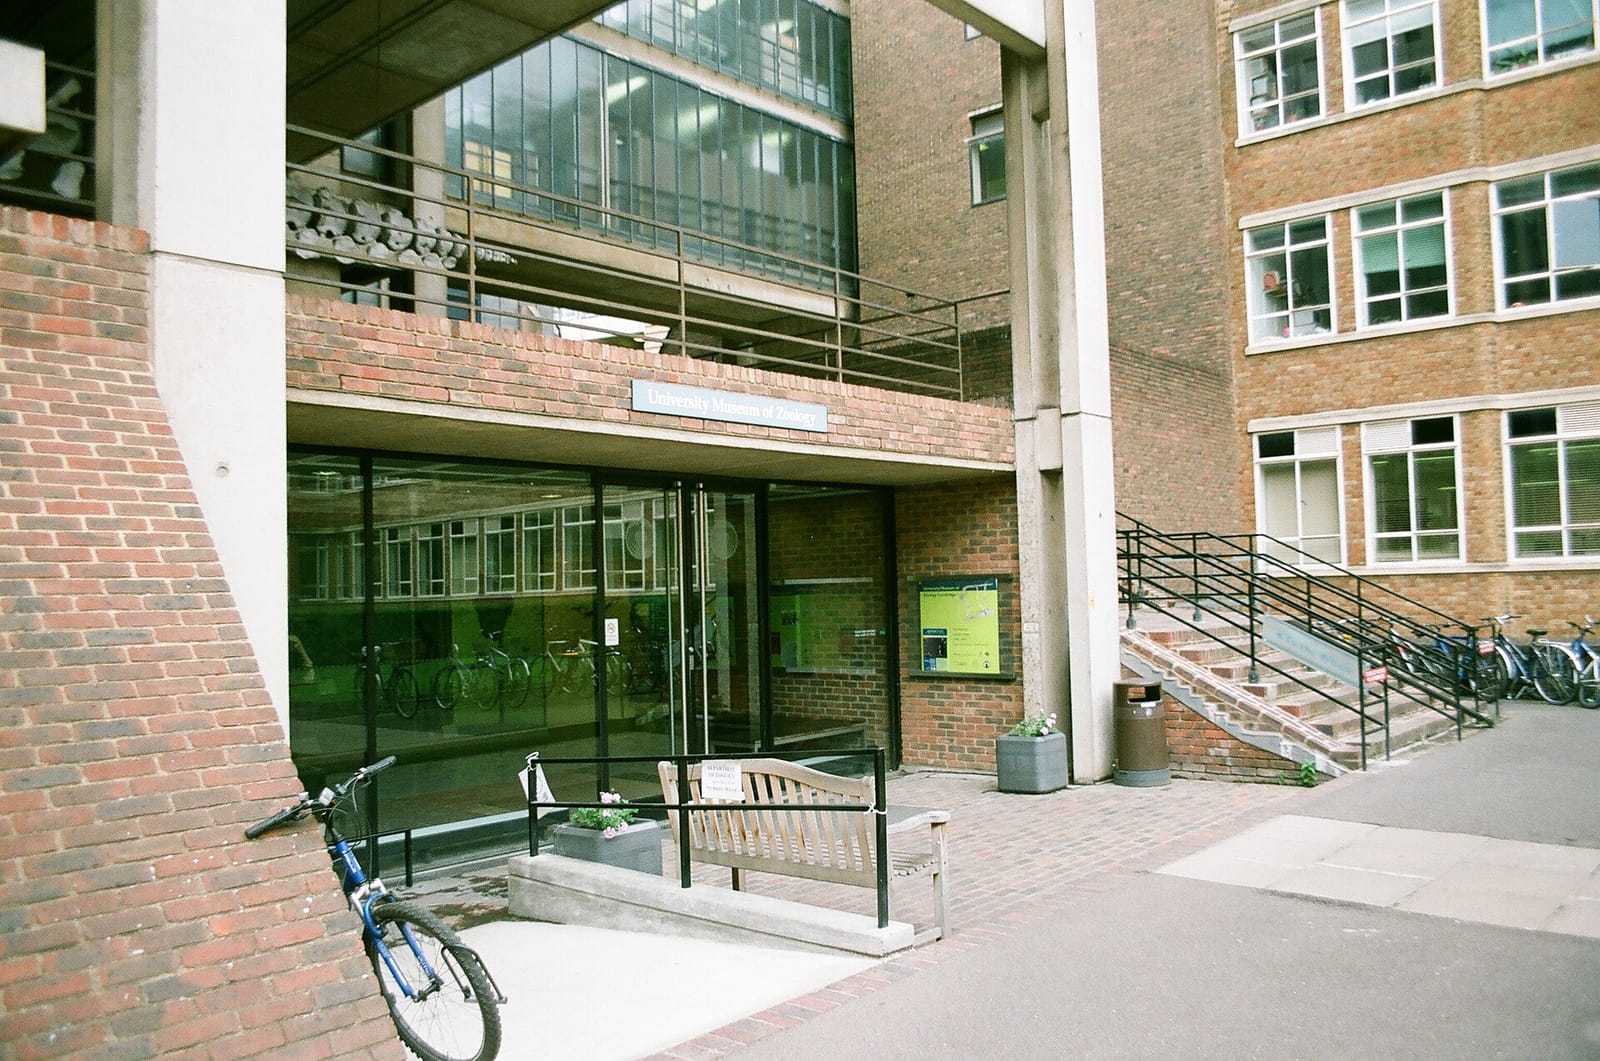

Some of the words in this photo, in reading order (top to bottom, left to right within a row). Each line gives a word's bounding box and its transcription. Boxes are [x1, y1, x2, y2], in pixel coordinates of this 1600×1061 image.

[647, 388, 708, 415] University
[711, 401, 760, 419] Museum
[762, 405, 774, 419] of
[776, 407, 817, 428] Zoology
